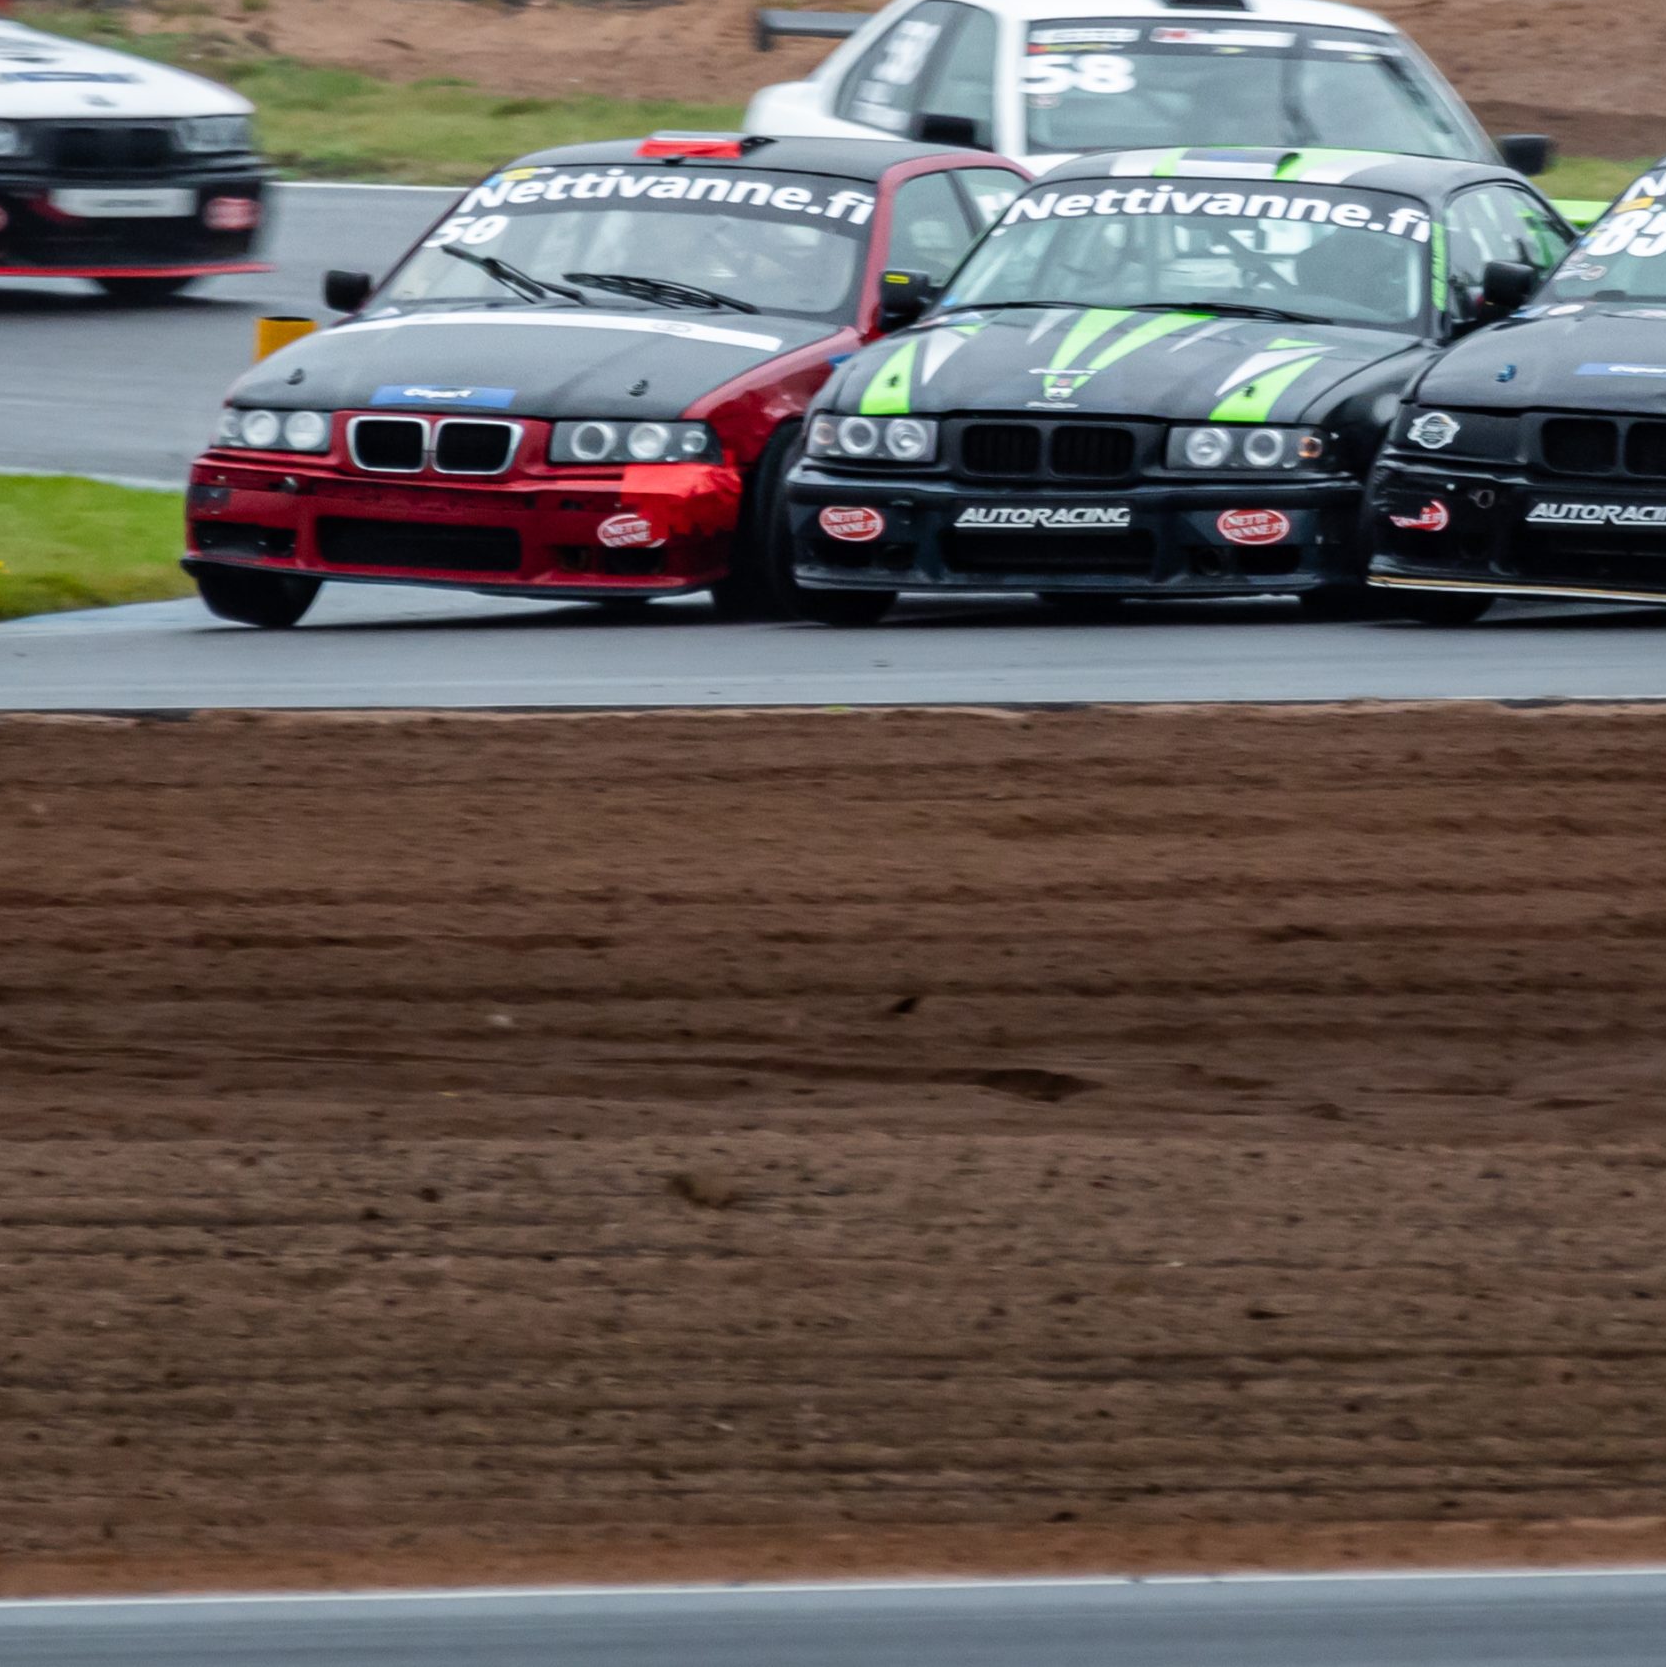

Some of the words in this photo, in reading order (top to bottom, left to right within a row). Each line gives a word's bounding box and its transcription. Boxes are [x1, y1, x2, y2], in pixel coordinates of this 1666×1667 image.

[1018, 53, 1137, 94] 58
[457, 168, 877, 226] Nettivanne.fi
[1002, 185, 1431, 244] Nettivanne.fi
[954, 507, 1131, 528] AUTORACING
